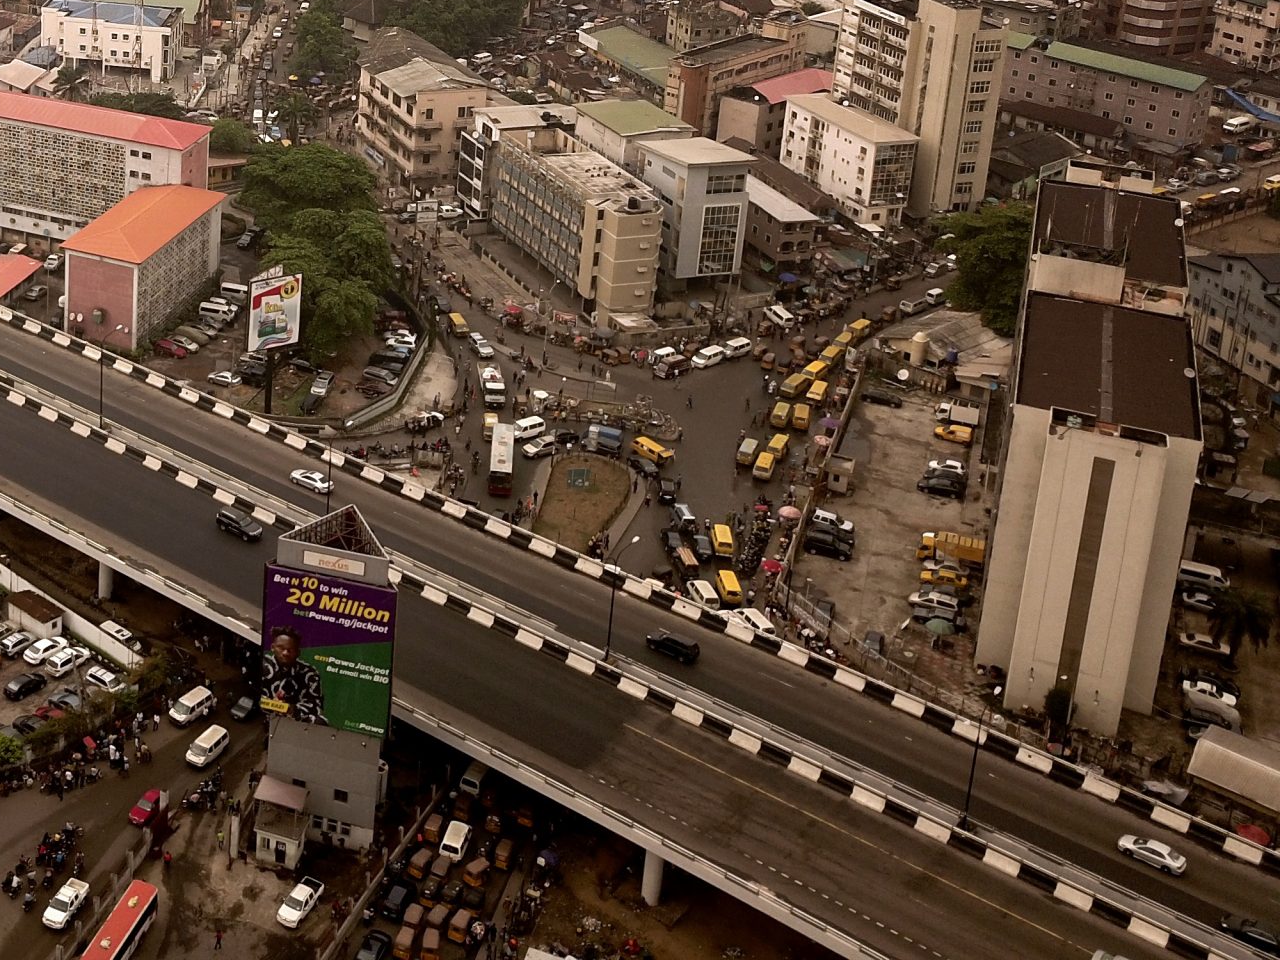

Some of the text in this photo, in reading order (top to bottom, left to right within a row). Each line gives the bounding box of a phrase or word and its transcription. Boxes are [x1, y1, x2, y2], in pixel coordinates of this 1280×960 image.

[318, 558, 350, 571] nexus
[273, 574, 290, 585] Bet
[301, 576, 318, 590] 10
[320, 583, 329, 592] to
[331, 586, 348, 596] win
[286, 588, 390, 623] 20 Million
[314, 655, 390, 676] emPawa Jackpot
[326, 665, 389, 684] Bet small win BIG
